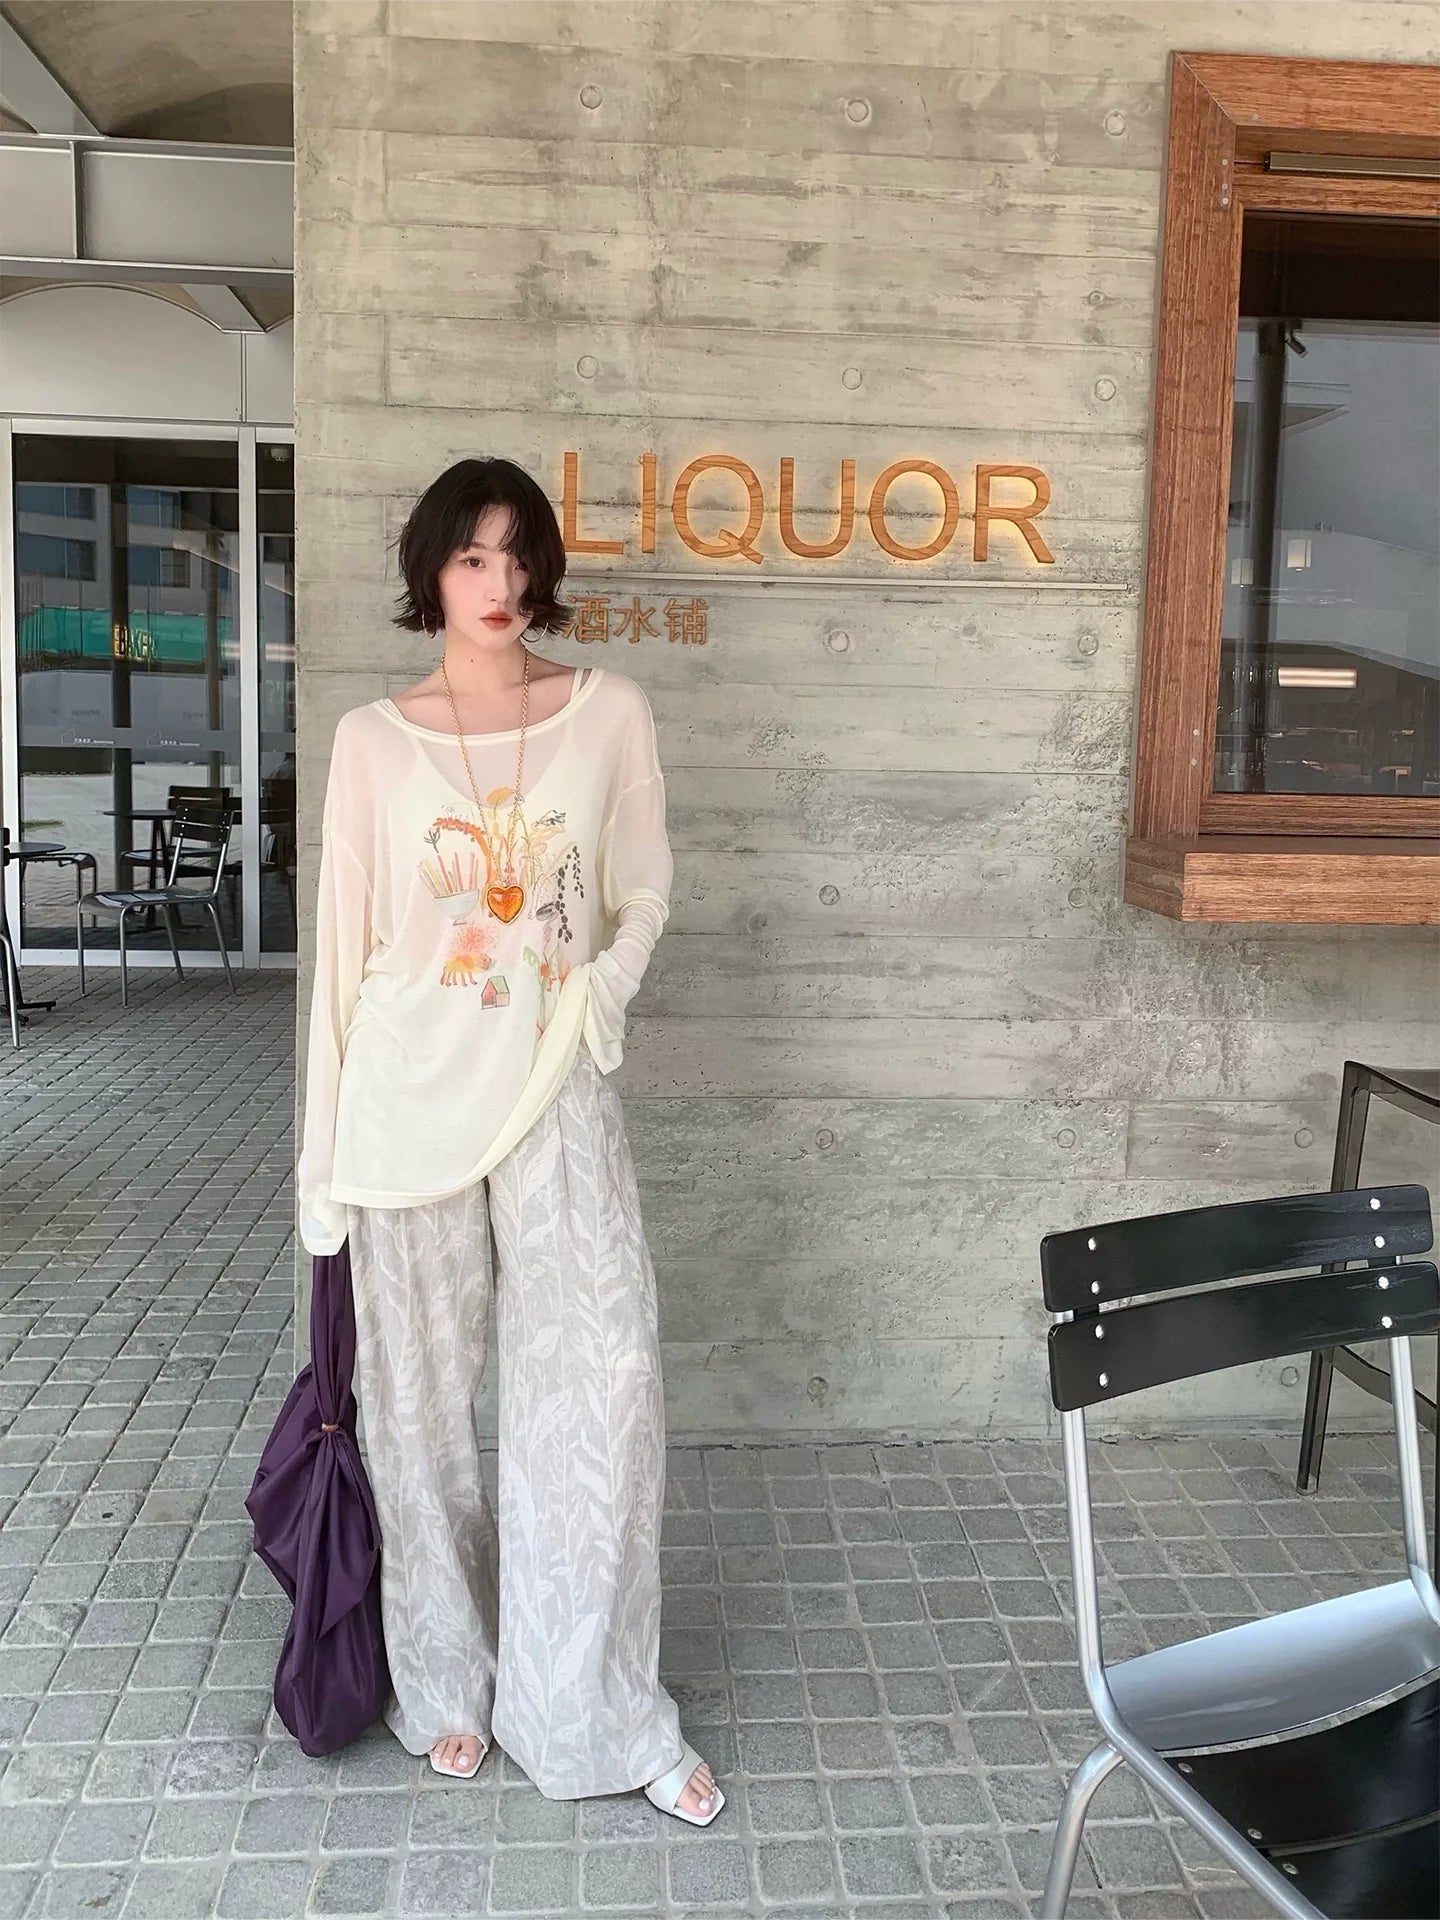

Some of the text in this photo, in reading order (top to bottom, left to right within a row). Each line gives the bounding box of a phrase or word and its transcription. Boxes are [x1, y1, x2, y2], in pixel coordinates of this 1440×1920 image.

[563, 452, 1055, 564] LIQUOR
[562, 596, 709, 645] 酒水铺
